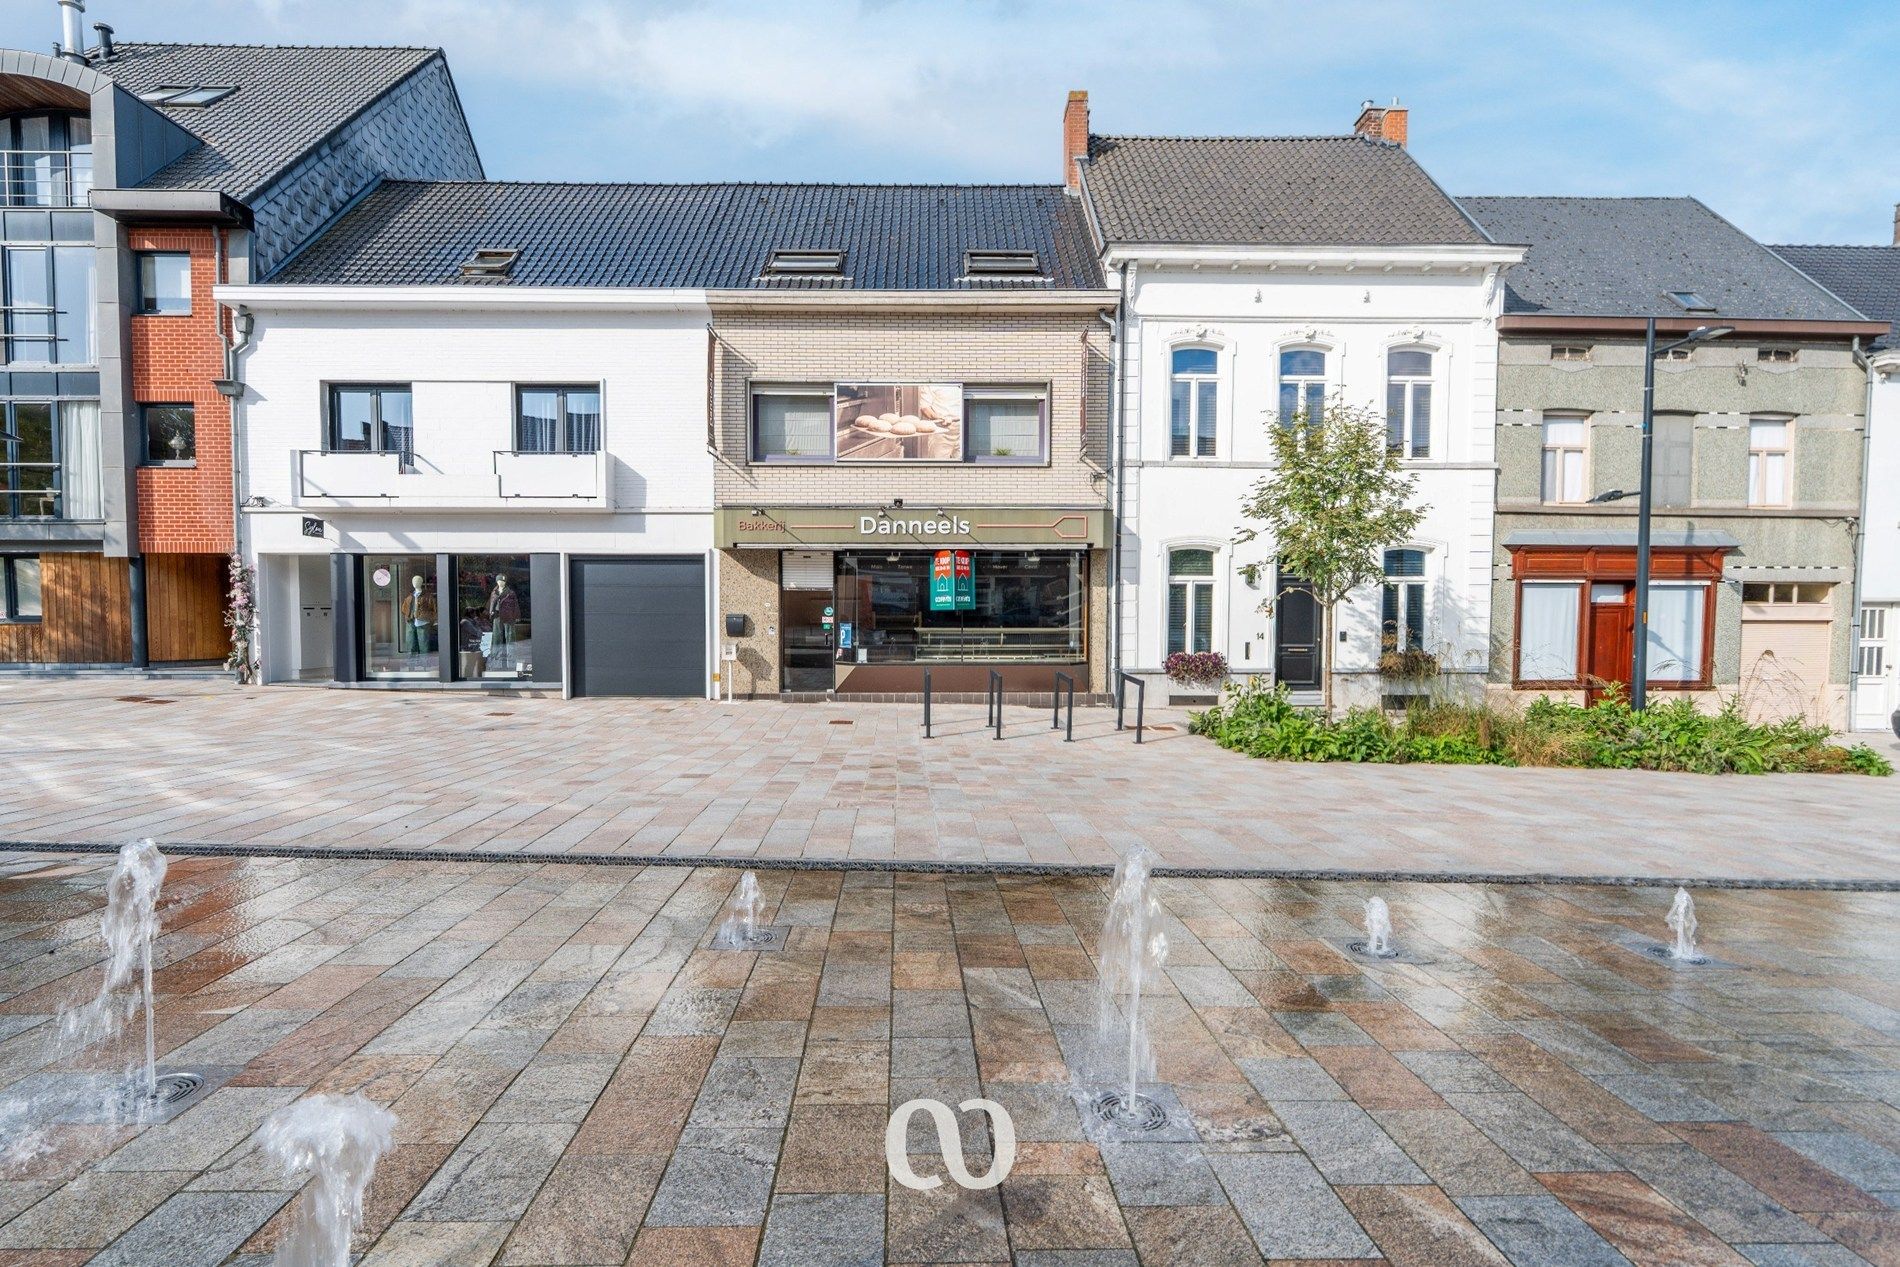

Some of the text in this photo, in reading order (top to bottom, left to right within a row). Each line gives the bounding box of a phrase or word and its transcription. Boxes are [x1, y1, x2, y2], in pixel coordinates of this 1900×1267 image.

[738, 520, 786, 533] Bakkerij
[860, 515, 971, 535] Danneels
[1256, 632, 1264, 640] 14
